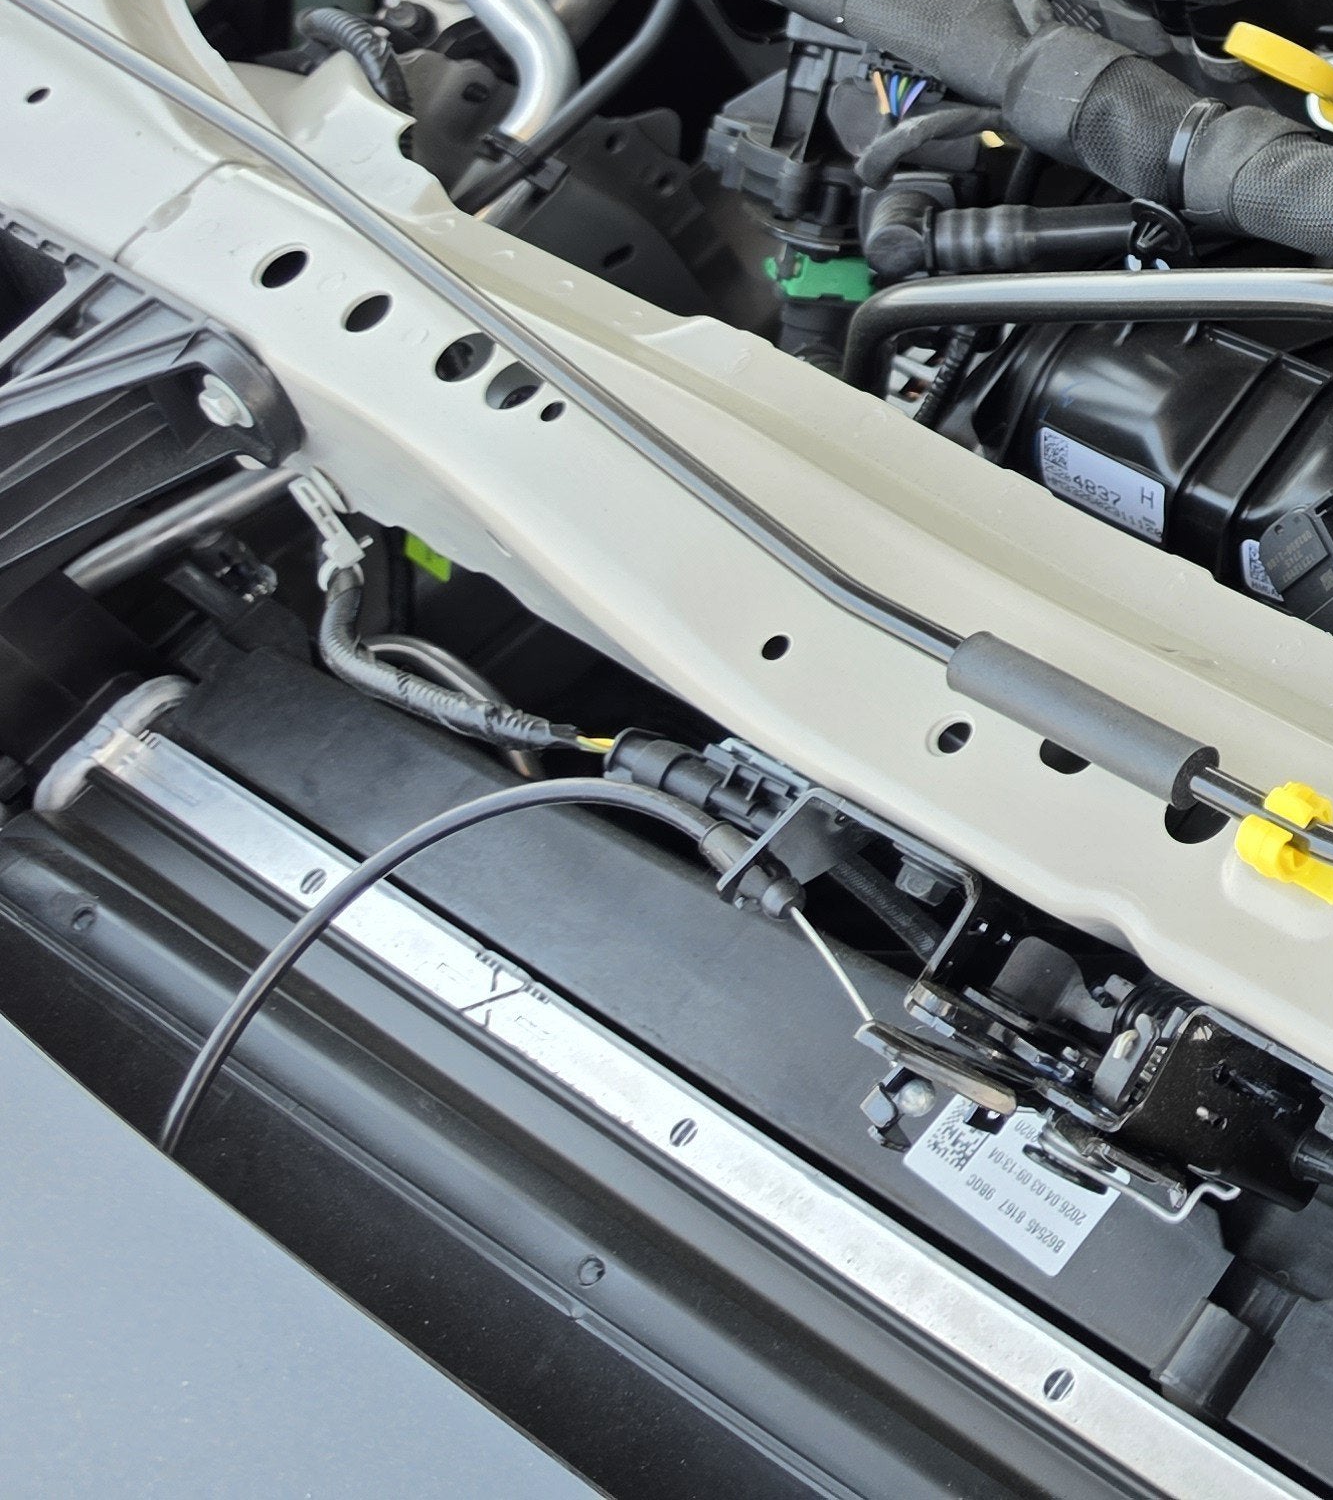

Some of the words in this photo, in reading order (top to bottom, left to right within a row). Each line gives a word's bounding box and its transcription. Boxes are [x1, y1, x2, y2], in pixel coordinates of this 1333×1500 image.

[1073, 474, 1122, 506] 4837
[1141, 486, 1155, 510] H
[987, 1146, 1034, 1185] 09:13:04
[997, 1198, 1027, 1224] 8167
